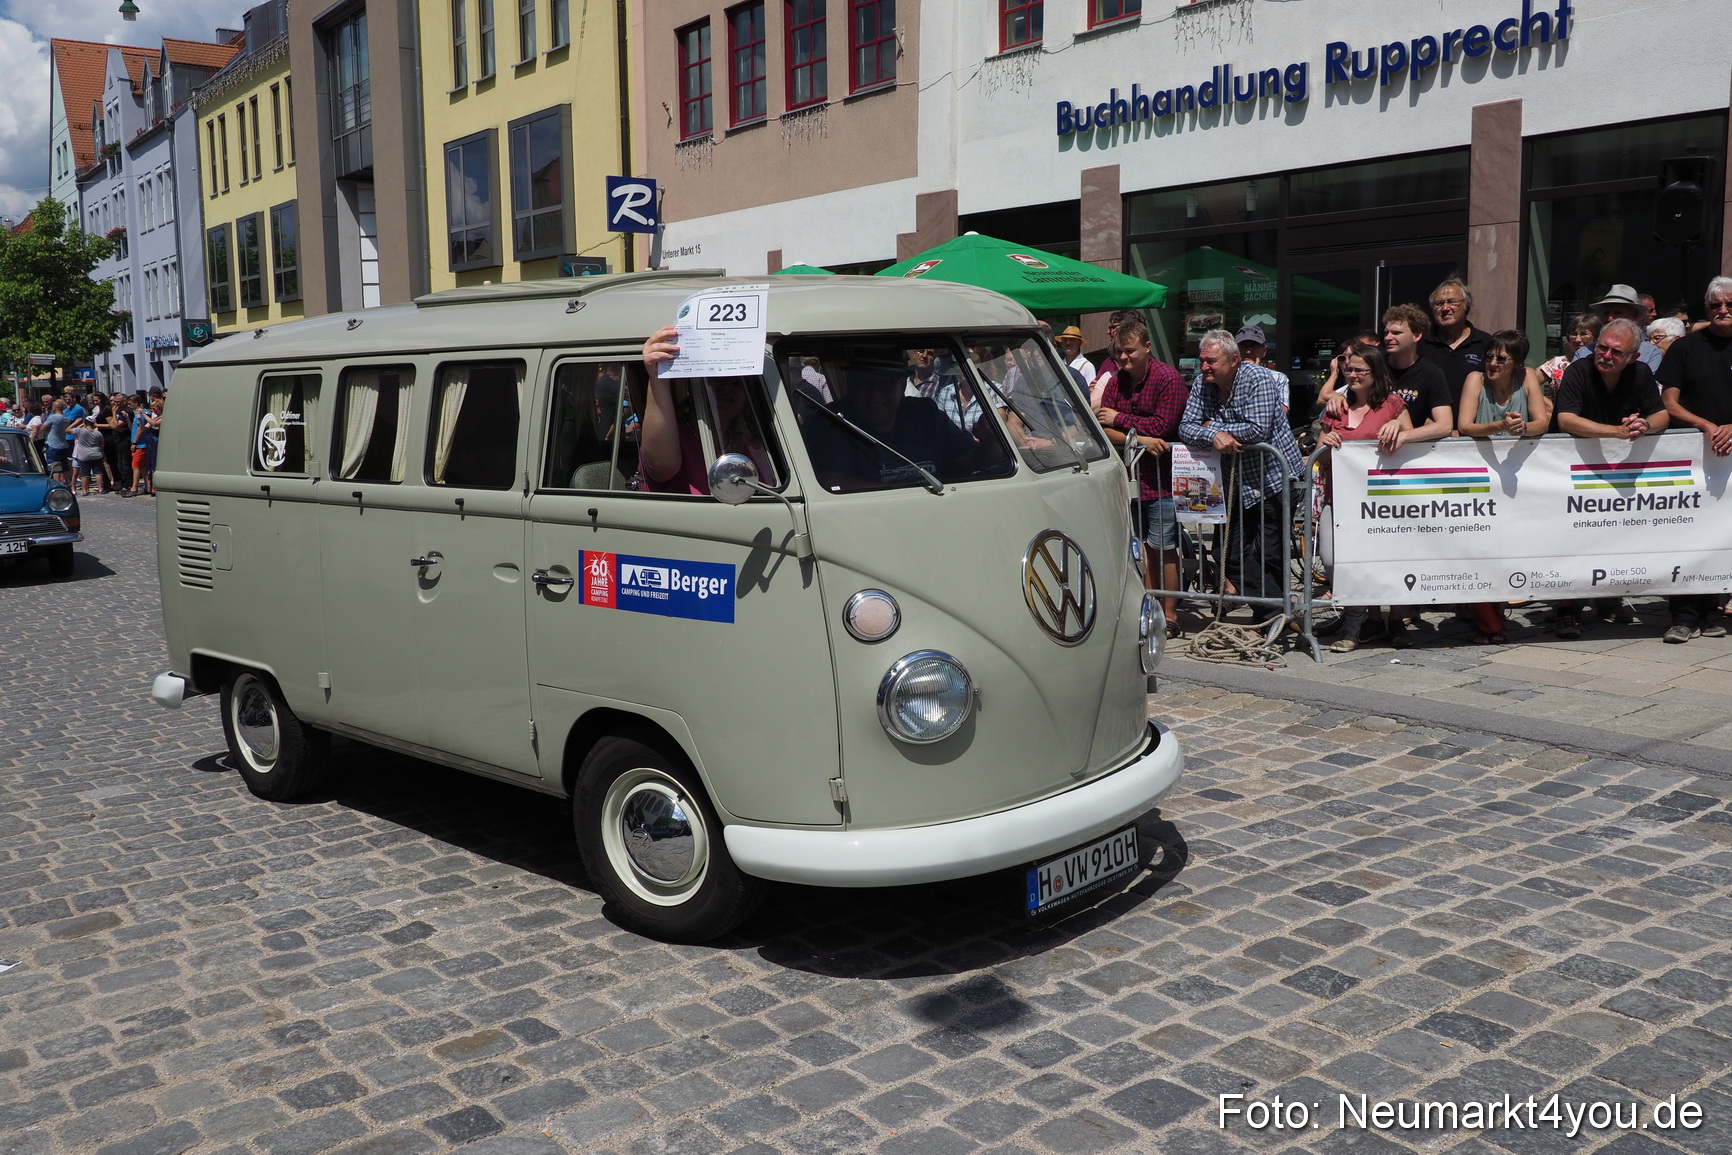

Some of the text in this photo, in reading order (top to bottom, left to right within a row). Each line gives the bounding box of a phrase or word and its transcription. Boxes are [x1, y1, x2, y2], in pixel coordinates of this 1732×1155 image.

[1057, 0, 1574, 136] Buchhandlung Rupprecht
[662, 244, 701, 260] Unterer Markt 15
[1190, 291, 1221, 301] OLDTIMER
[709, 303, 747, 322] 223
[1567, 491, 1701, 513] NeuerMarkt
[1361, 498, 1496, 520] NeuerMarkt
[1573, 515, 1694, 529] einkaufen leben genießen
[1367, 523, 1491, 534] einkaufen leben genießen
[6, 542, 27, 553] 12H
[591, 559, 608, 577] 60
[1610, 567, 1647, 576] über 500
[1420, 573, 1472, 582] Dammstraße
[1530, 571, 1561, 579] Mo.-Sa.
[591, 577, 608, 588] JAHRE
[671, 568, 727, 599] Berger
[1420, 583, 1460, 592] Neumarkt
[1468, 582, 1476, 591] d.
[1477, 582, 1494, 591] OPf.
[1557, 580, 1572, 589] Uhr
[1610, 577, 1651, 586] Parkplätze
[591, 588, 608, 597] CAMPING
[621, 587, 669, 600] CAMPING UND FREIZEIT
[1039, 867, 1052, 901] H
[1030, 893, 1036, 902] D
